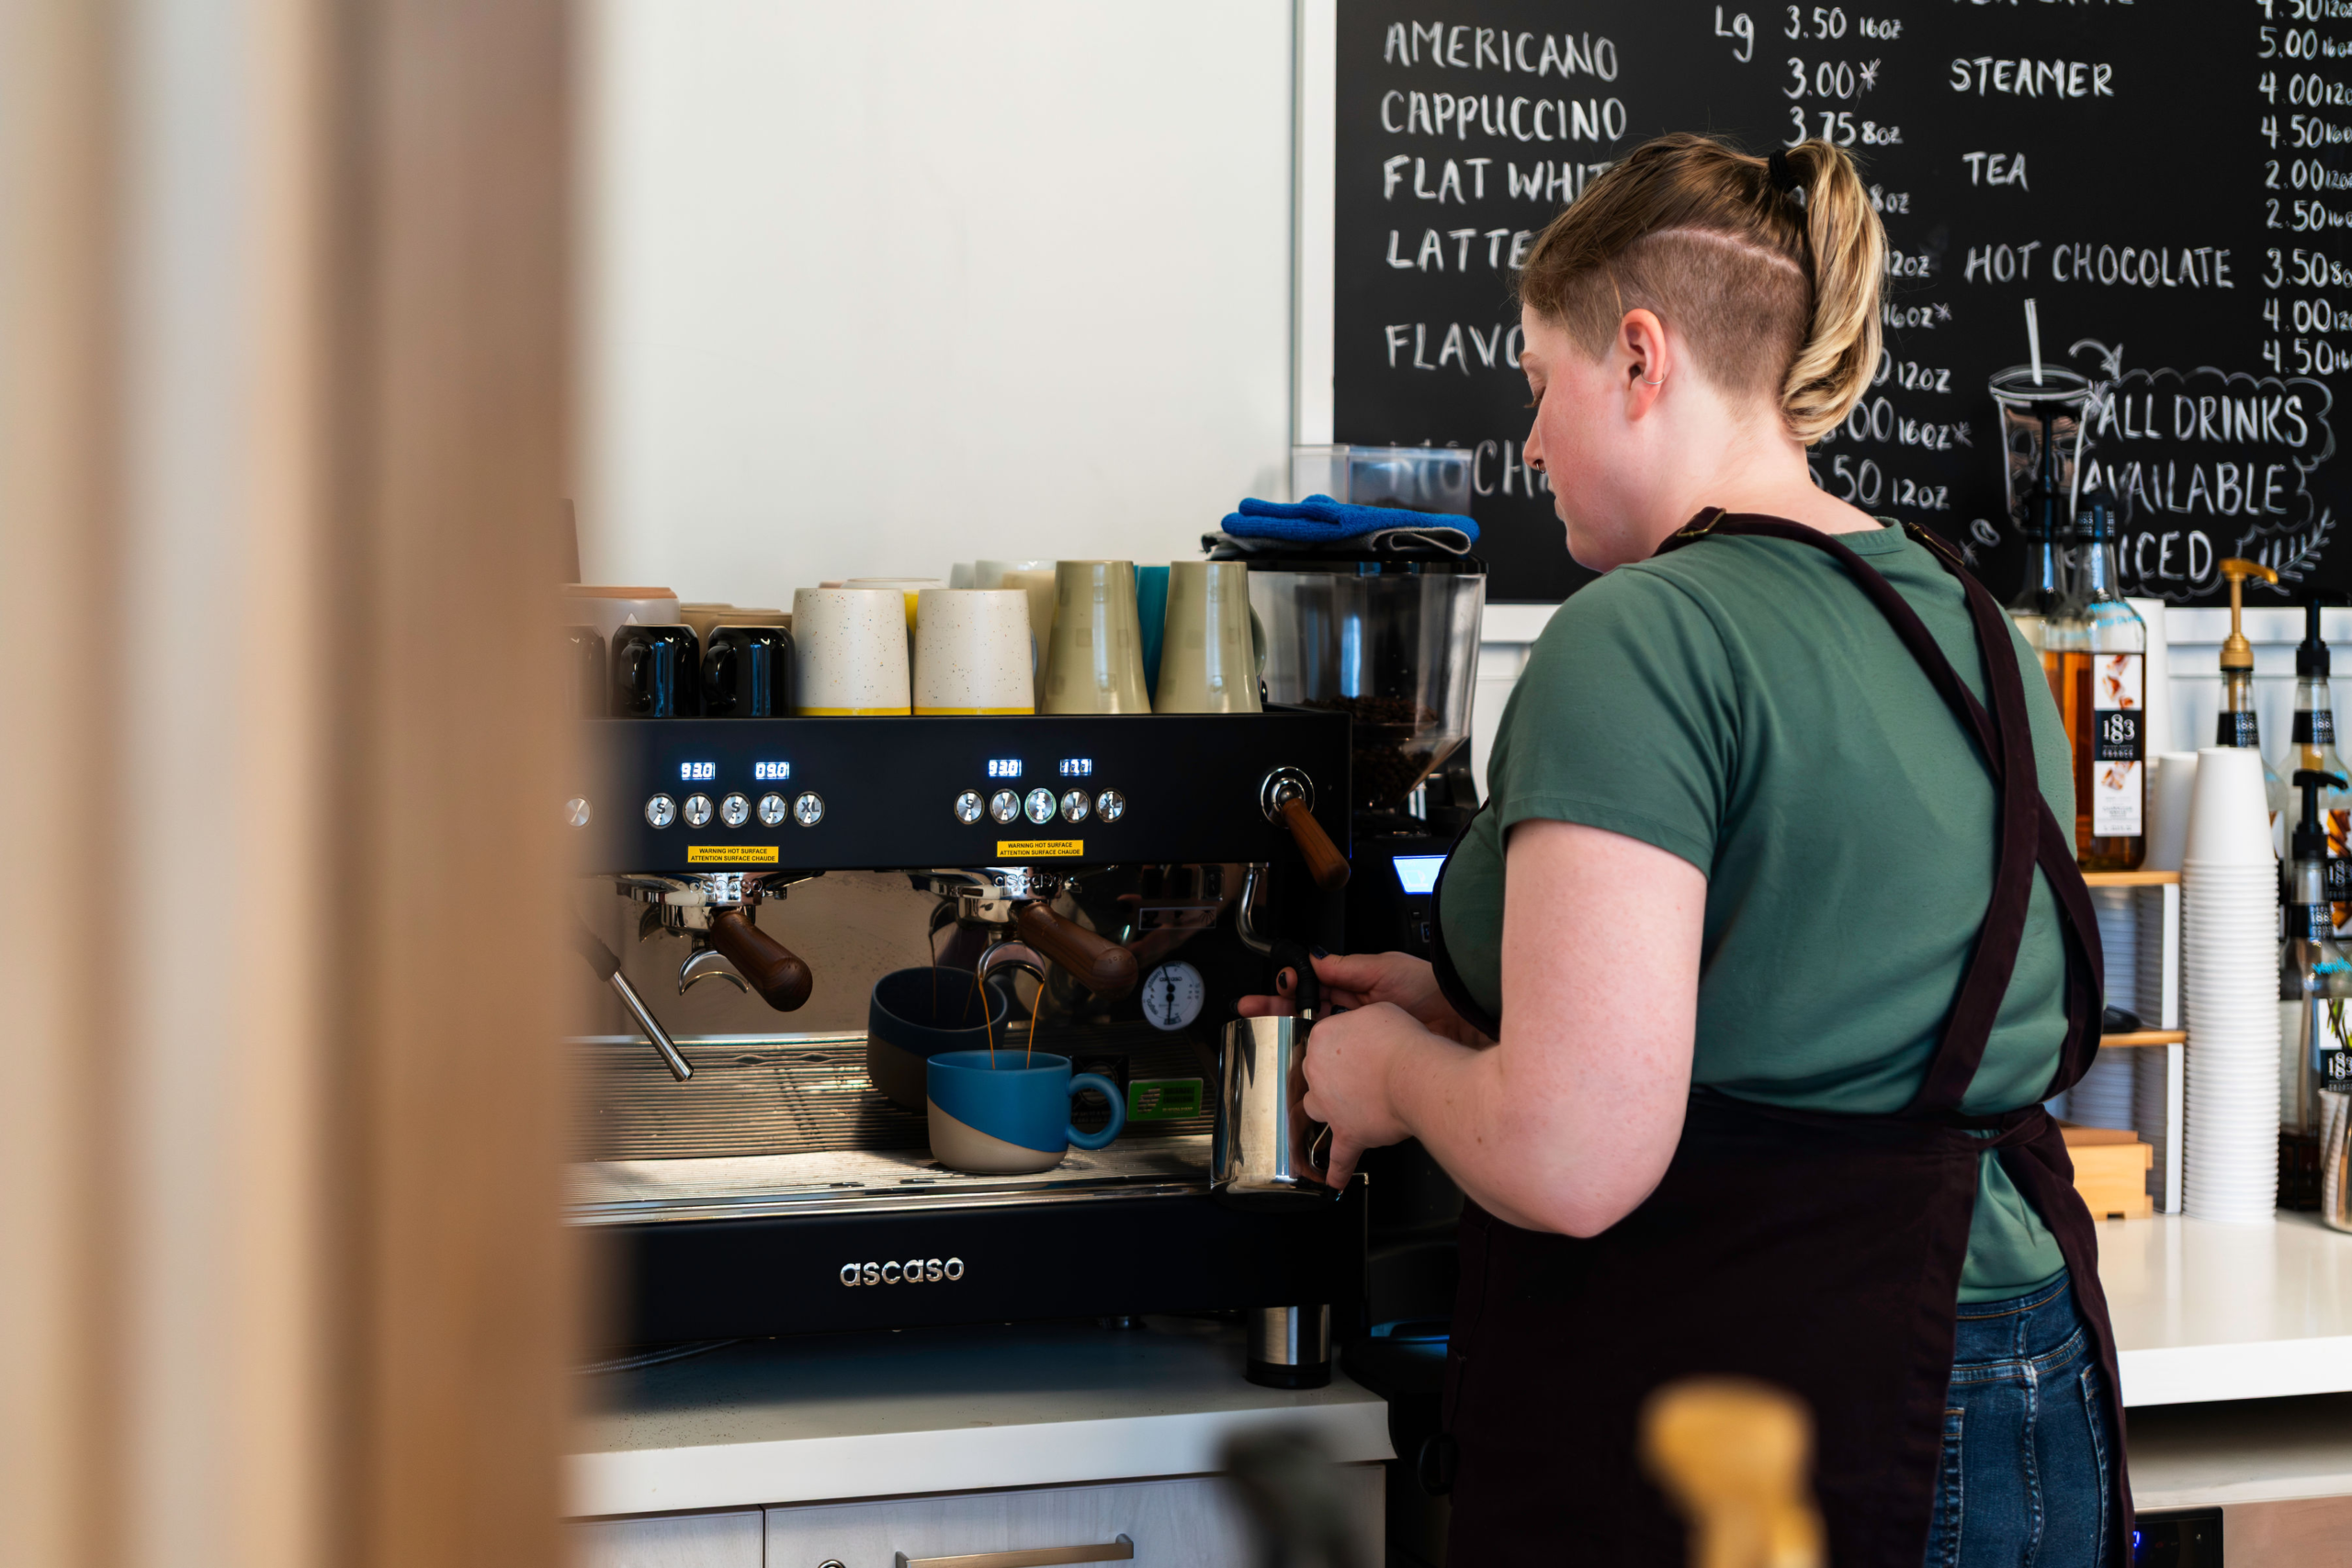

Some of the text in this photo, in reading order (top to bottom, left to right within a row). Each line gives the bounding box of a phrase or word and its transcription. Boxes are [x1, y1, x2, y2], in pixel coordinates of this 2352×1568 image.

[1784, 5, 1848, 40] 3.50
[1383, 20, 1618, 83] AMERICANO
[2257, 26, 2318, 61] 5.00
[1949, 56, 2114, 99] STEAMER
[2258, 70, 2324, 107] 4.00
[1380, 89, 1627, 141] CAPPUCCINO
[1782, 106, 1857, 147] 375
[2260, 114, 2324, 150] 4.50
[1383, 153, 1493, 205] FLAT
[1962, 152, 2028, 191] TEA
[2265, 158, 2324, 192] 2.00
[2265, 197, 2326, 232] 2.50
[1386, 228, 1532, 273] LATTE
[1963, 241, 2234, 288] HOT CHOCOLATE
[2263, 247, 2329, 289] 3.50
[2263, 297, 2332, 333] 4.00
[2262, 337, 2335, 375] 4.50
[2097, 391, 2309, 447] ALL DRINKS
[2082, 459, 2288, 517] AVAILABLE
[2119, 530, 2212, 583] ICED
[656, 803, 666, 815] S
[695, 801, 705, 814] L
[730, 802, 741, 814] S
[768, 801, 778, 813] L
[800, 801, 820, 814] XL
[840, 1257, 965, 1288] ascaso
